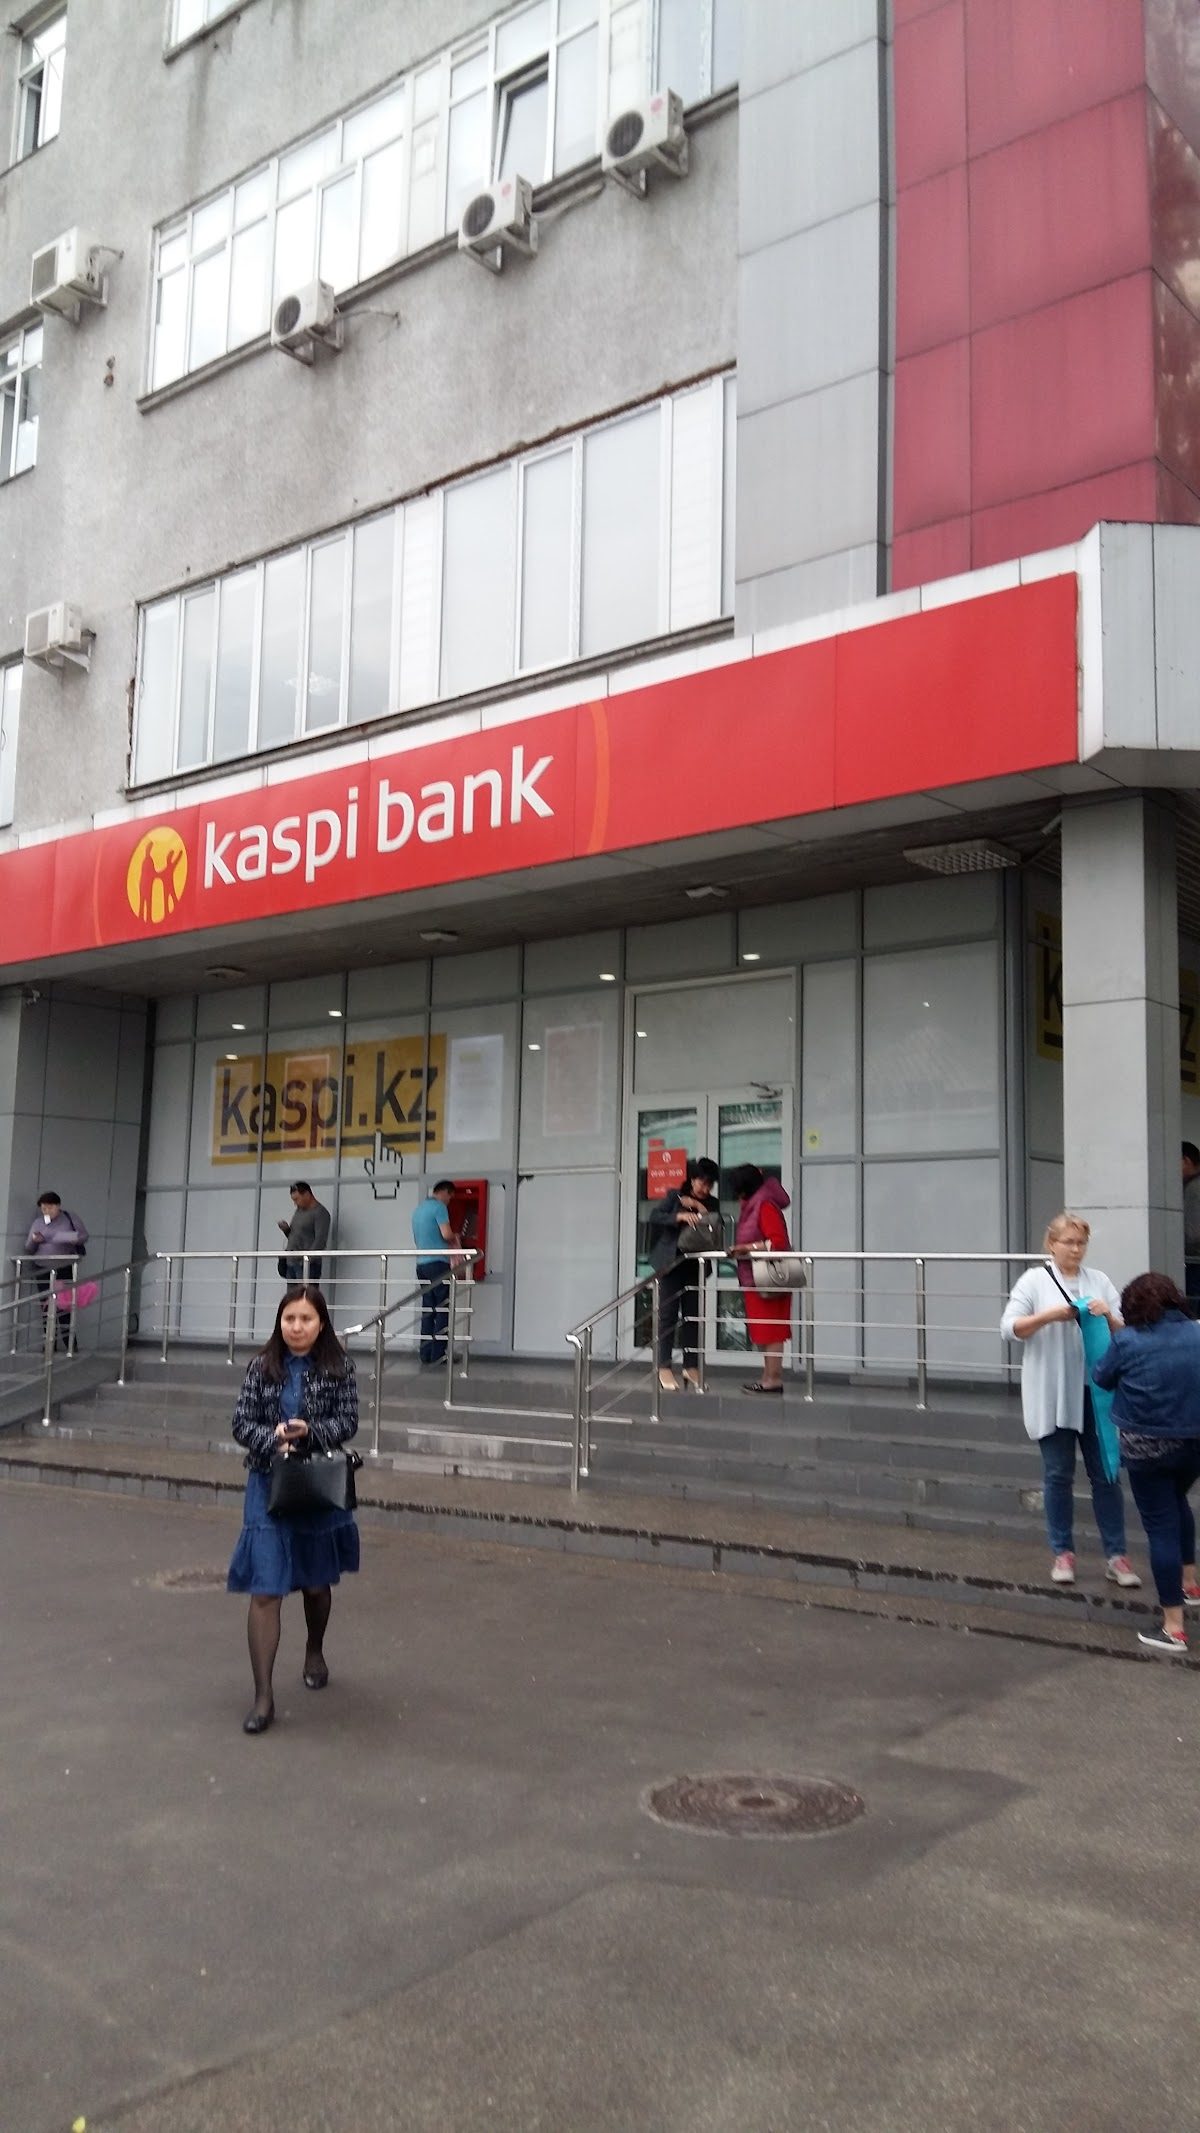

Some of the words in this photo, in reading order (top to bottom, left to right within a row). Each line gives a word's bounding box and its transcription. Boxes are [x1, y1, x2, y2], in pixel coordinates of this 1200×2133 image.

[204, 787, 358, 889] kaspi
[377, 745, 554, 852] bank
[221, 1051, 438, 1149] kaspi.kz
